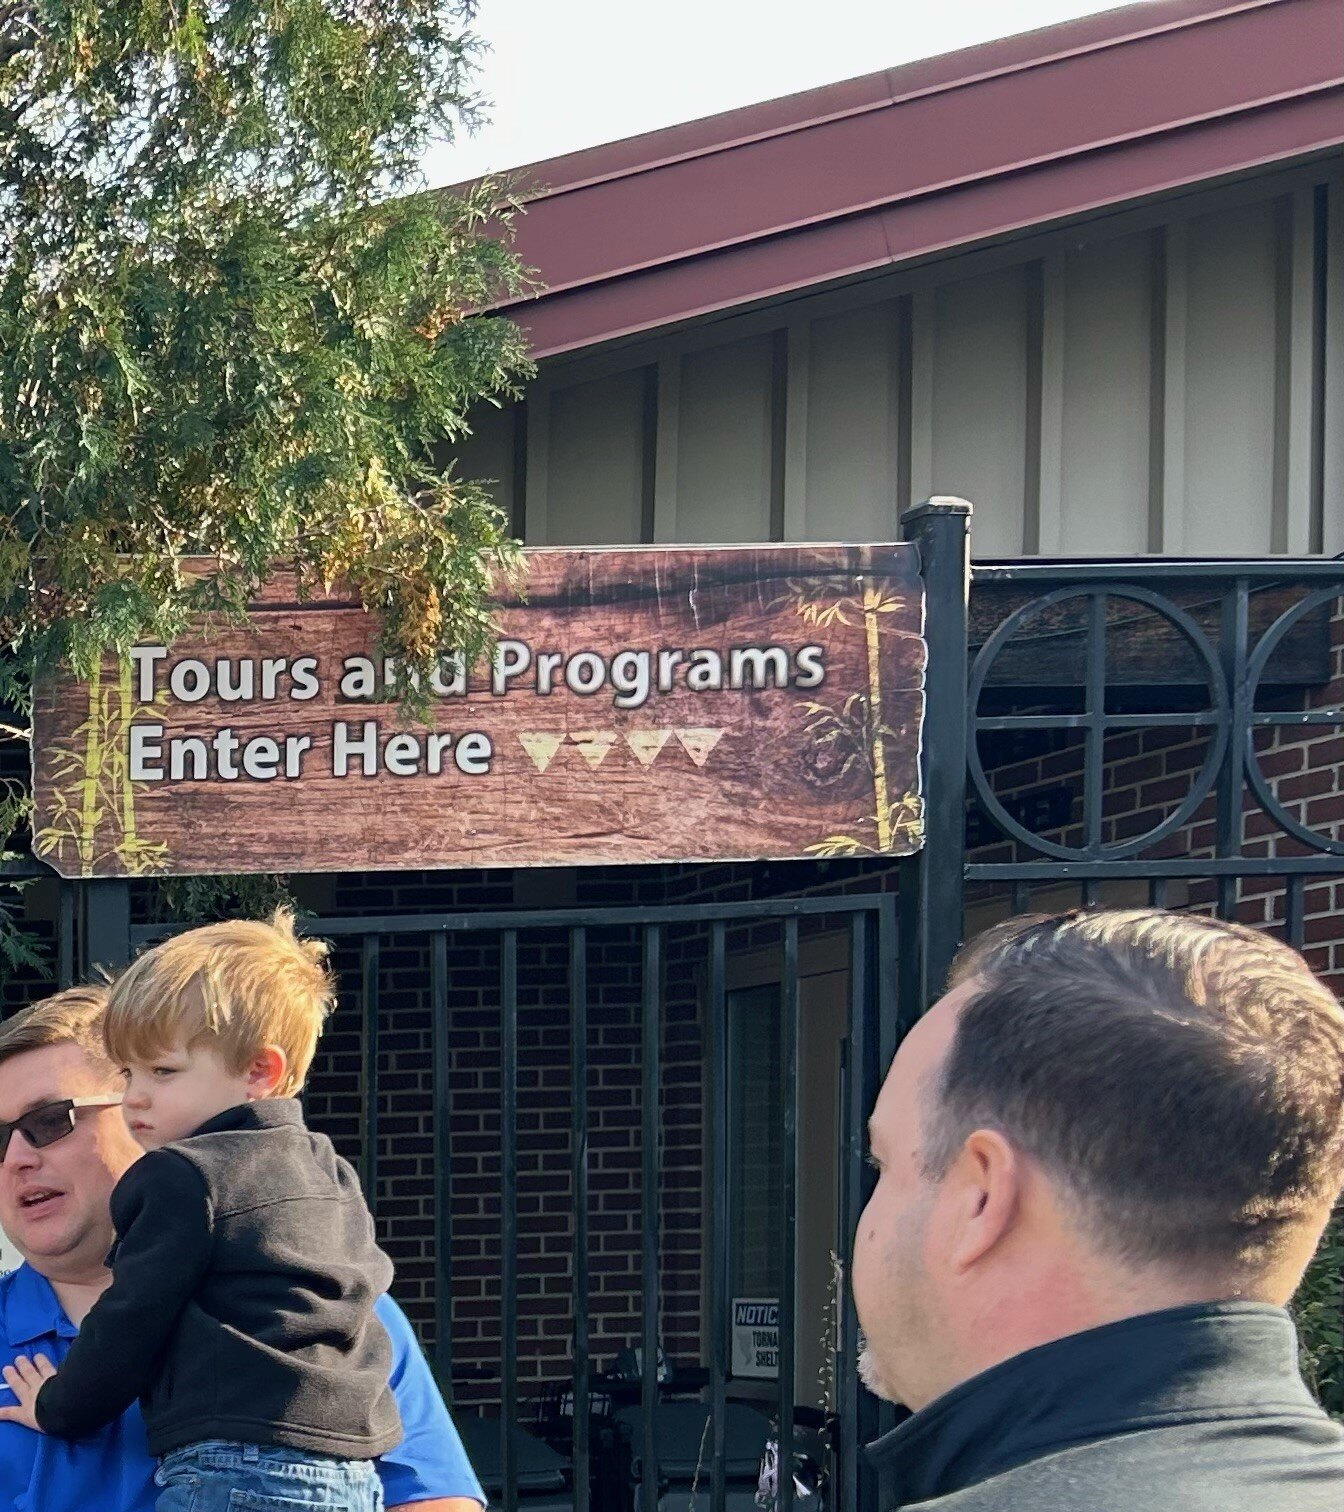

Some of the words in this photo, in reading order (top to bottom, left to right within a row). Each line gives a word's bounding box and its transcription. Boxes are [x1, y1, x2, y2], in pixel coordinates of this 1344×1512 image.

[129, 646, 320, 702] Tours
[492, 640, 825, 708] Programs
[129, 723, 311, 781] Enter
[333, 721, 492, 777] Here
[736, 1305, 779, 1324] NOTIC
[752, 1330, 778, 1348] TORNA
[755, 1350, 780, 1367] SHELT
